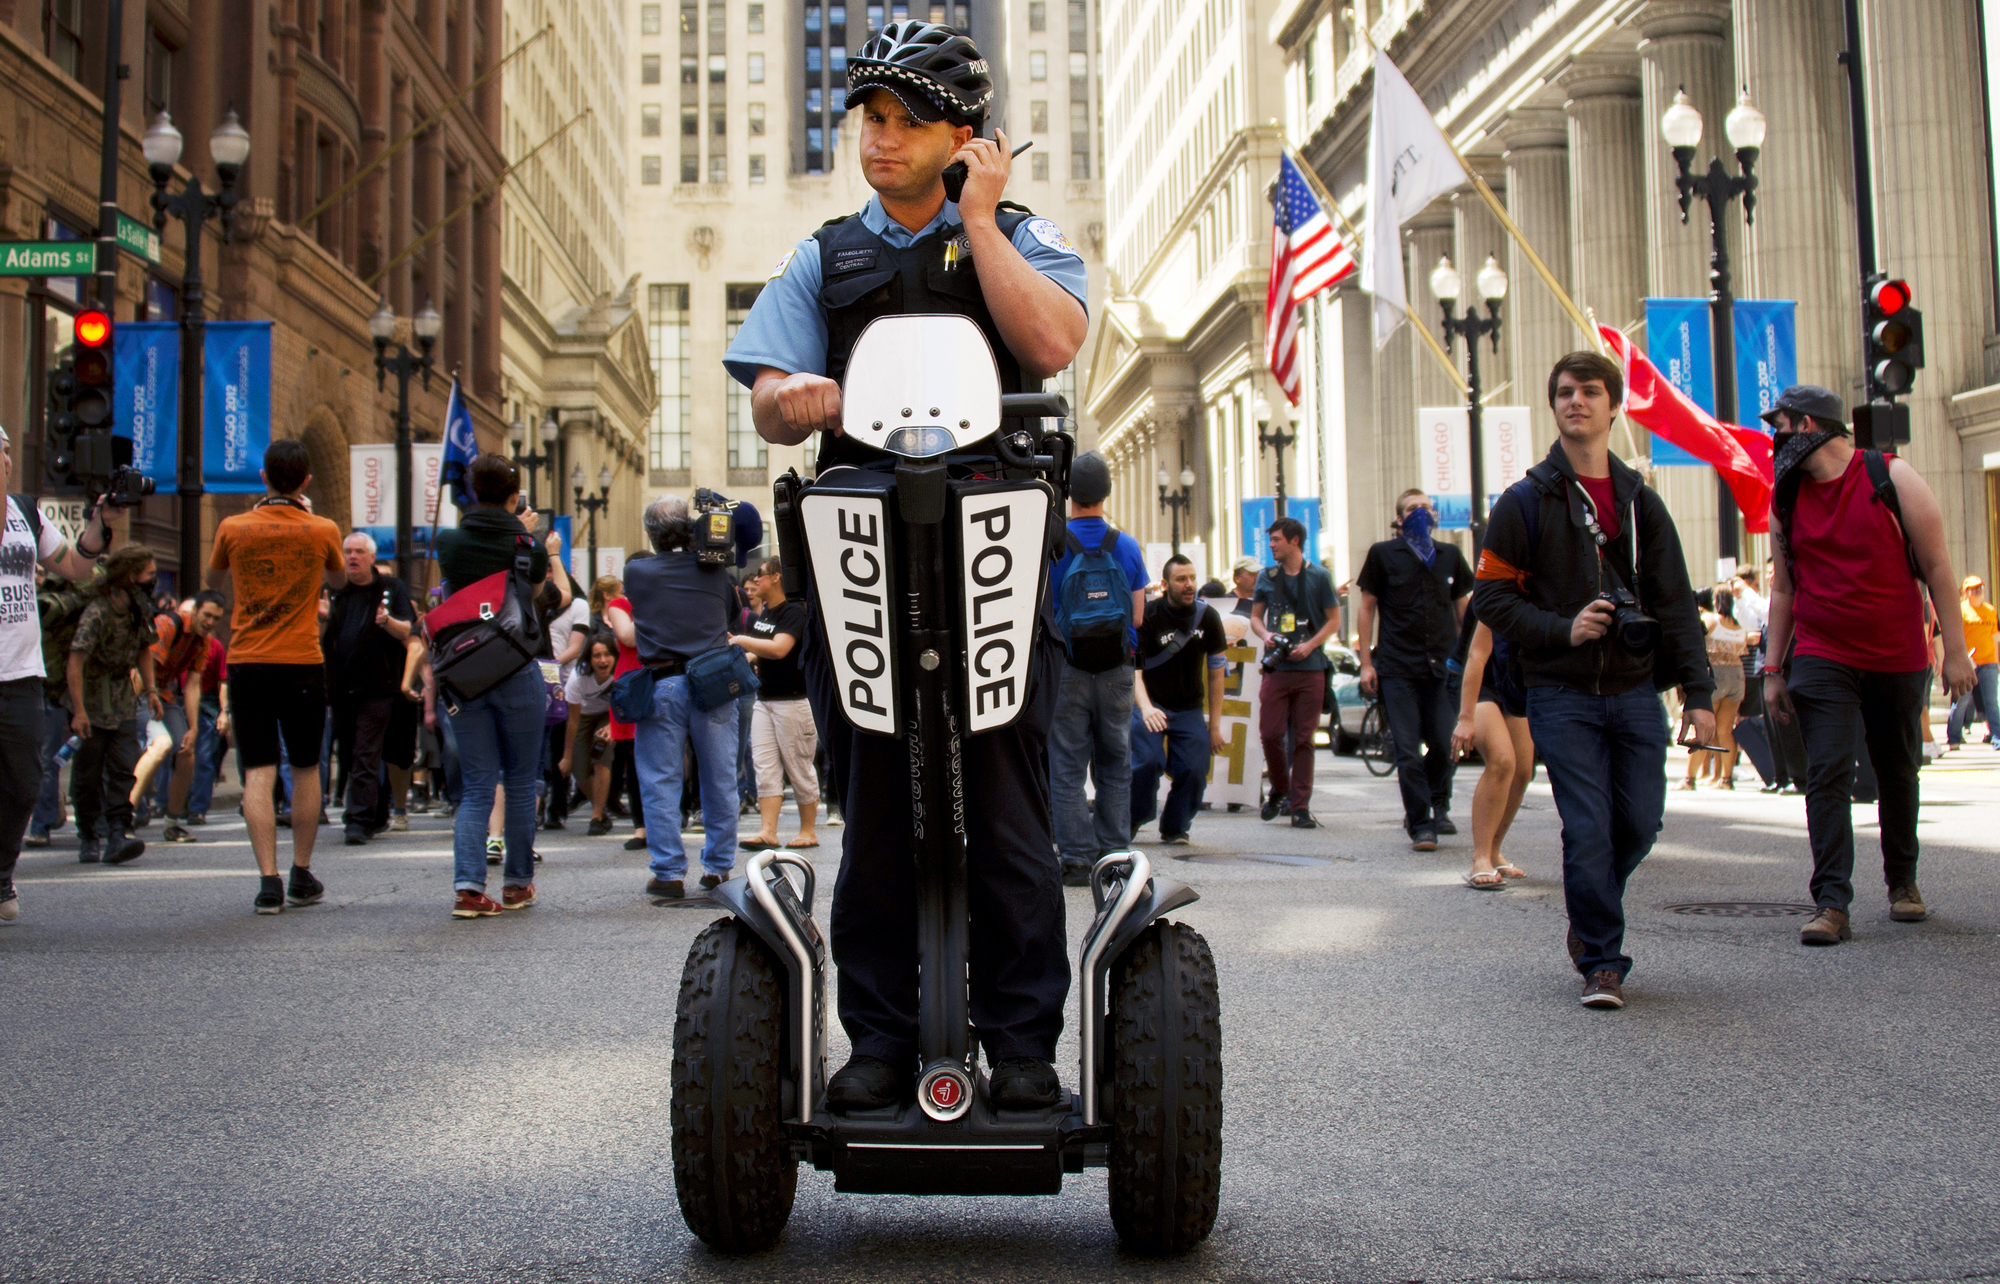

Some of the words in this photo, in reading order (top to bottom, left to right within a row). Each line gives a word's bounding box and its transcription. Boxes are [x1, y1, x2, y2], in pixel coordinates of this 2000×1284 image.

[6, 248, 71, 267] Adams
[76, 252, 89, 263] St
[840, 262, 864, 270] CENTRAL
[145, 345, 157, 409] Crossroads
[237, 345, 249, 409] Crossroads
[1681, 321, 1692, 382] Crossroads
[1757, 361, 1769, 388] 2012
[1766, 324, 1778, 386] Crossroads
[133, 384, 145, 413] 2012
[225, 384, 238, 413] 2012
[144, 411, 156, 448] Global
[224, 414, 237, 472] CHICAGO
[235, 411, 248, 447] Global
[1434, 422, 1451, 492] CHICAGO
[234, 450, 247, 471] The
[45, 505, 82, 521] ONE
[364, 457, 380, 524] CHICAGO
[424, 456, 439, 524] CHICAGO
[837, 507, 888, 717] POLICE
[969, 504, 1017, 717] POLICE
